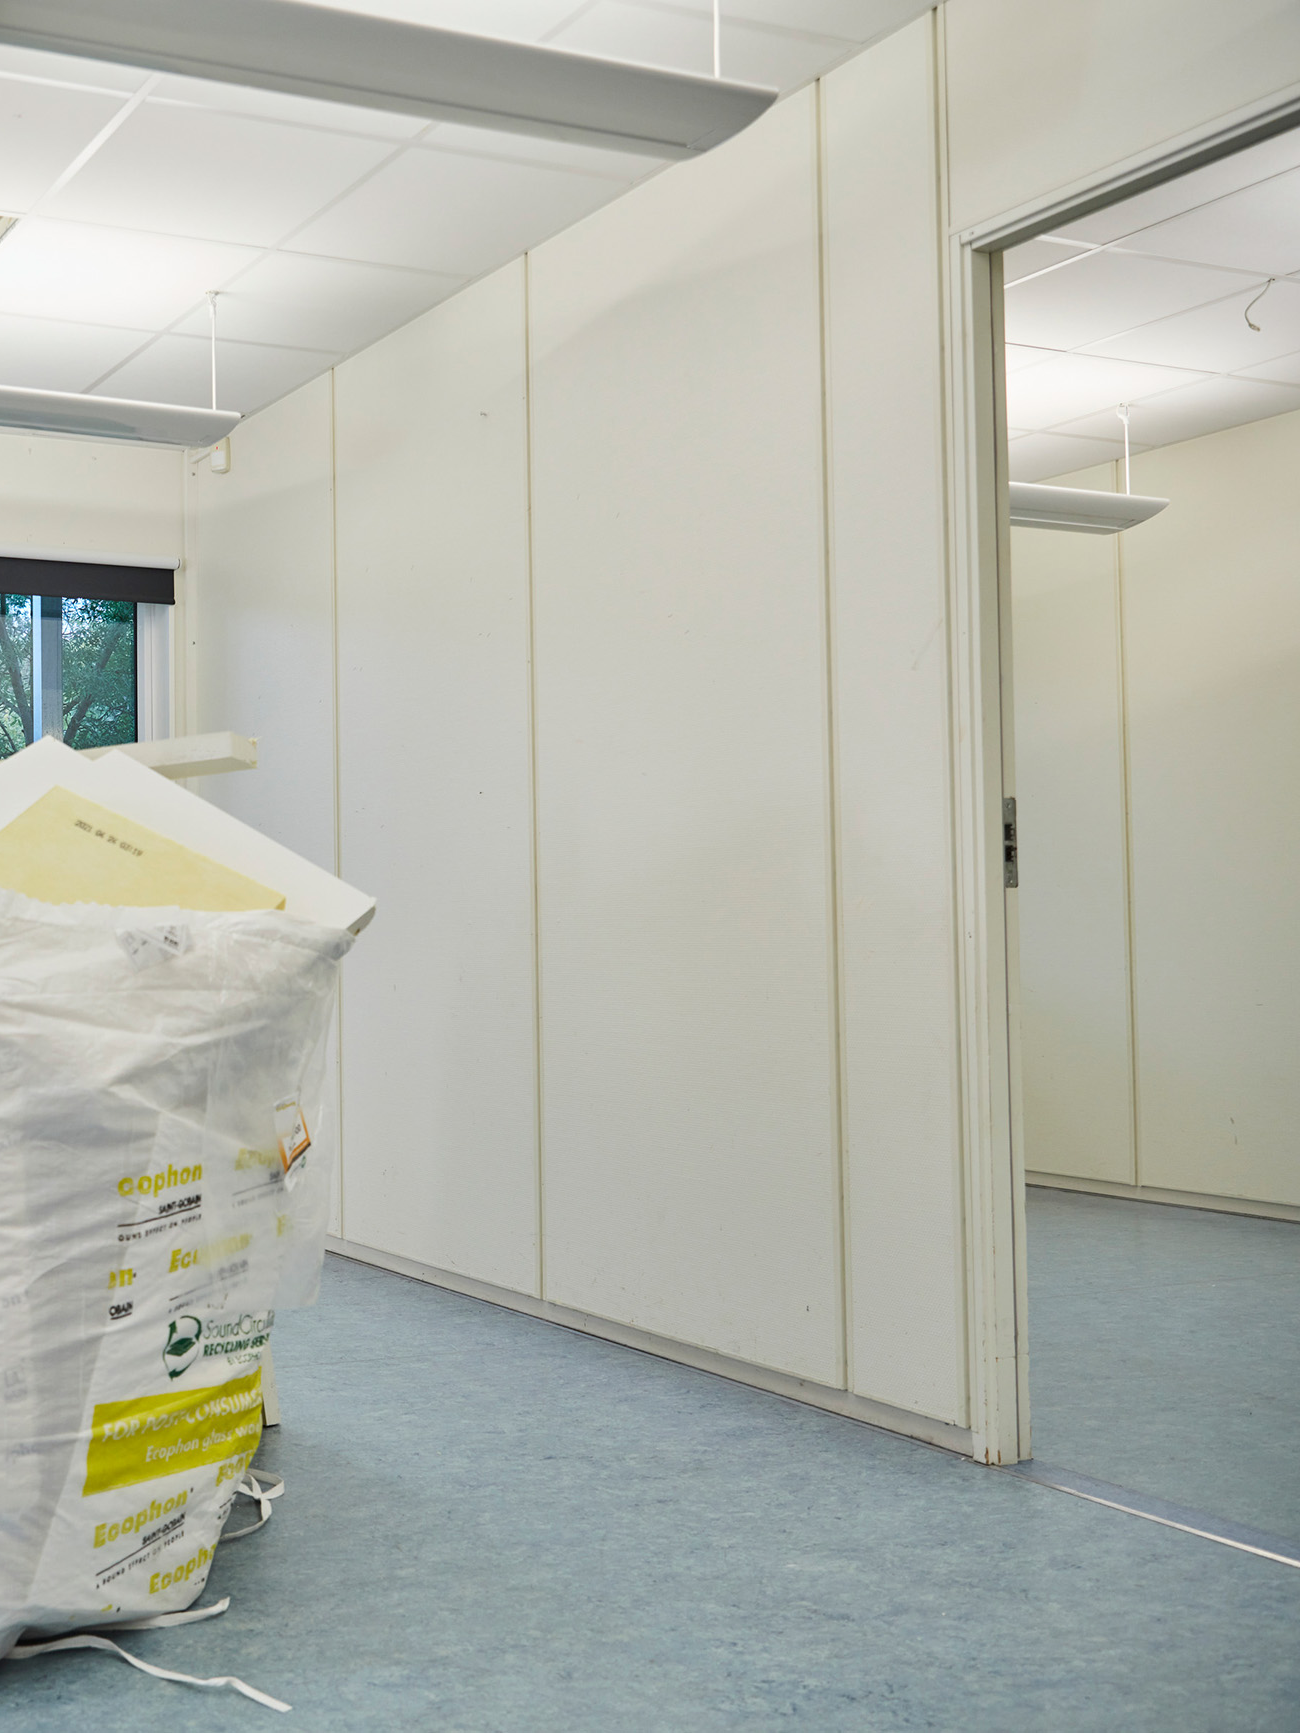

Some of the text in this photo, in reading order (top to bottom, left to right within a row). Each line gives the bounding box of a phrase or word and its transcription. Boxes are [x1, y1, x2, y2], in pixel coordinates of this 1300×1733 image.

[117, 1164, 203, 1198] cophon
[102, 1419, 141, 1443] FOR
[145, 1438, 200, 1463] Ecophon
[202, 1428, 234, 1452] glass
[93, 1490, 188, 1549] Ecophon
